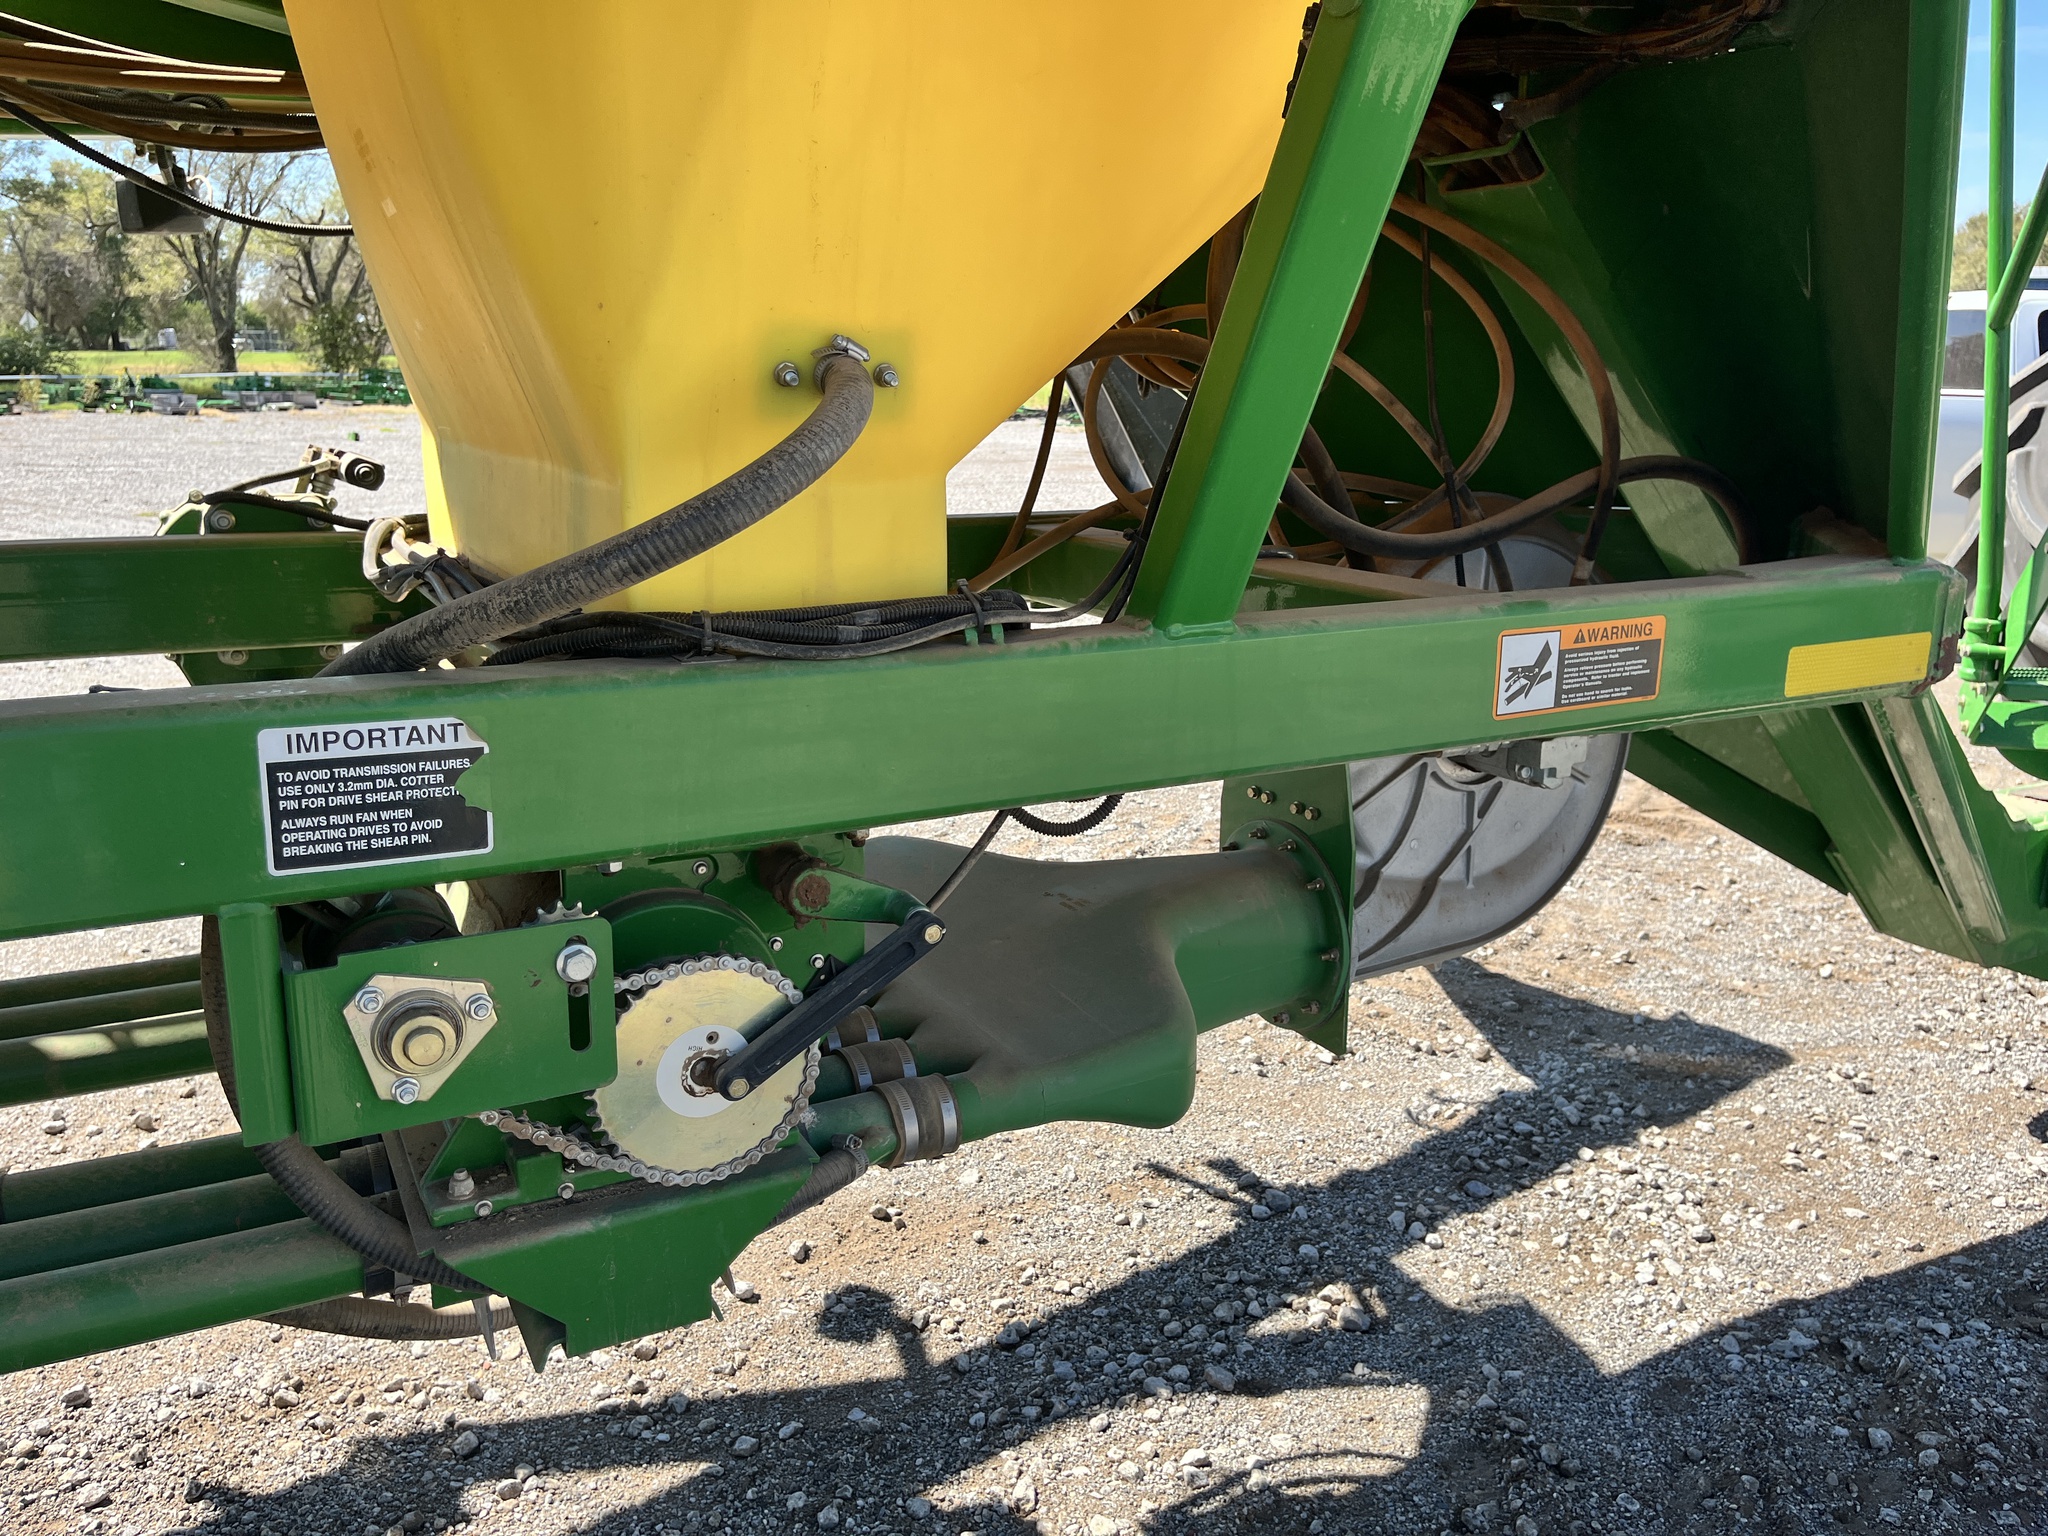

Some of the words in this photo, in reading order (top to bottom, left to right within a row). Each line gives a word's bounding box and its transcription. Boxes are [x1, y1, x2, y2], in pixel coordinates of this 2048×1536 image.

[1588, 622, 1653, 643] WARNING
[286, 722, 465, 755] IMPORTANT
[276, 771, 293, 782] TO
[295, 769, 330, 781] AVOID
[332, 762, 416, 778] TRANSMISSION
[277, 785, 302, 796] USE
[304, 782, 335, 794] ONLY
[337, 781, 373, 792] 3.2mm
[375, 777, 397, 788] DIA.
[400, 773, 444, 786] COTTER
[279, 799, 298, 810] PIN
[301, 797, 325, 808] FOR
[328, 793, 362, 806] DRIVE
[365, 790, 403, 803] SHEAR
[280, 815, 327, 829] ALWAYS
[329, 813, 353, 825] RUN
[355, 811, 377, 822] FAN
[379, 808, 412, 820] WHEN
[281, 827, 346, 843] OPERATING
[349, 823, 390, 837] DRIVES
[391, 821, 407, 832] TO
[409, 818, 442, 831] AVOID
[282, 841, 343, 857] BREAKING
[345, 839, 368, 850] THE
[370, 835, 408, 848] SHEAR
[410, 832, 431, 844] PIN.
